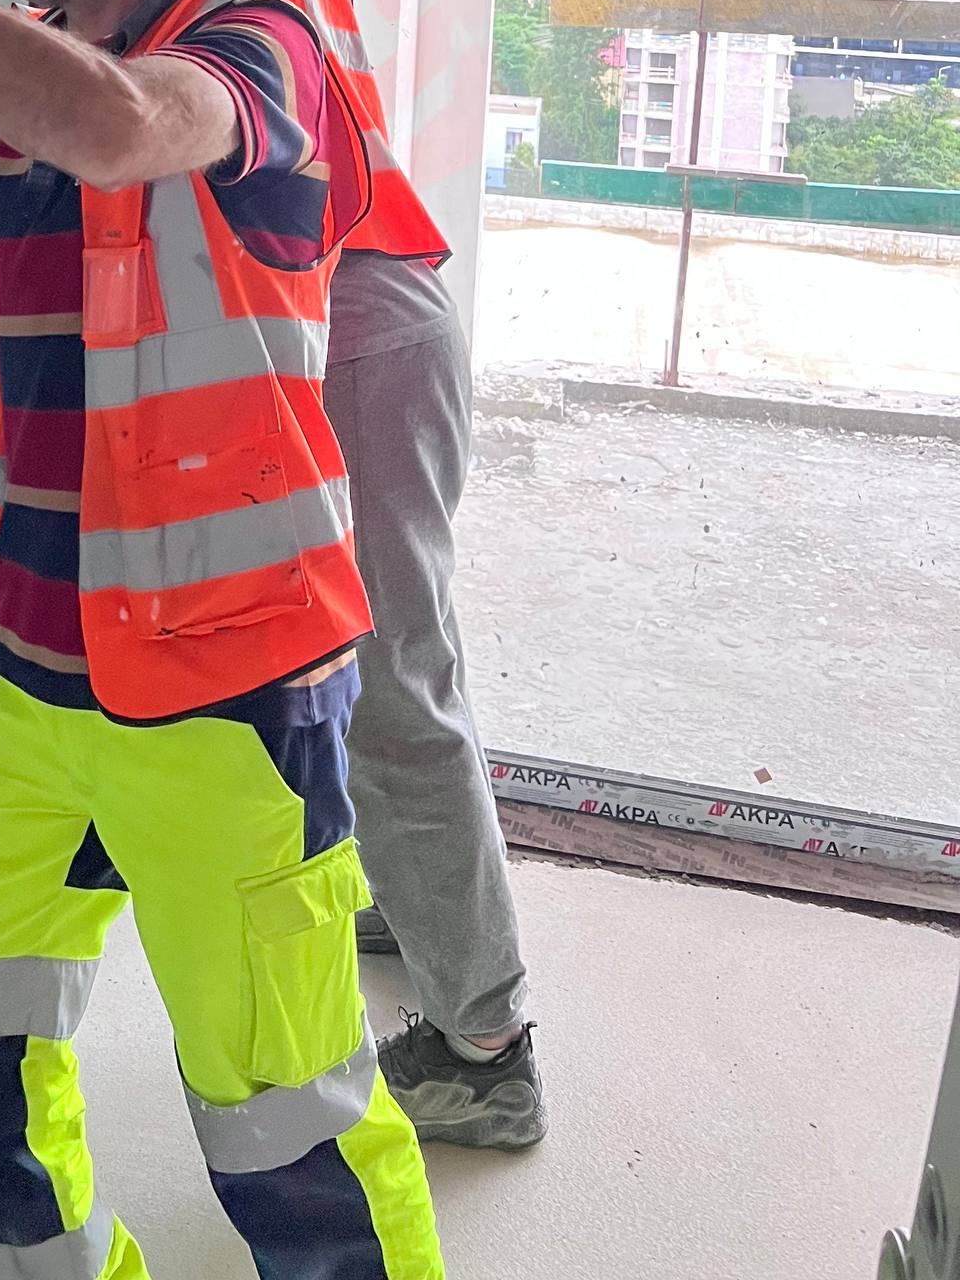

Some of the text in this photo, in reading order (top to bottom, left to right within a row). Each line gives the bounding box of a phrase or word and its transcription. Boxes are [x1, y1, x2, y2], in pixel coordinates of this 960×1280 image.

[510, 766, 572, 791] AKPA
[599, 801, 660, 826] AKPA
[730, 804, 795, 830] AKPA
